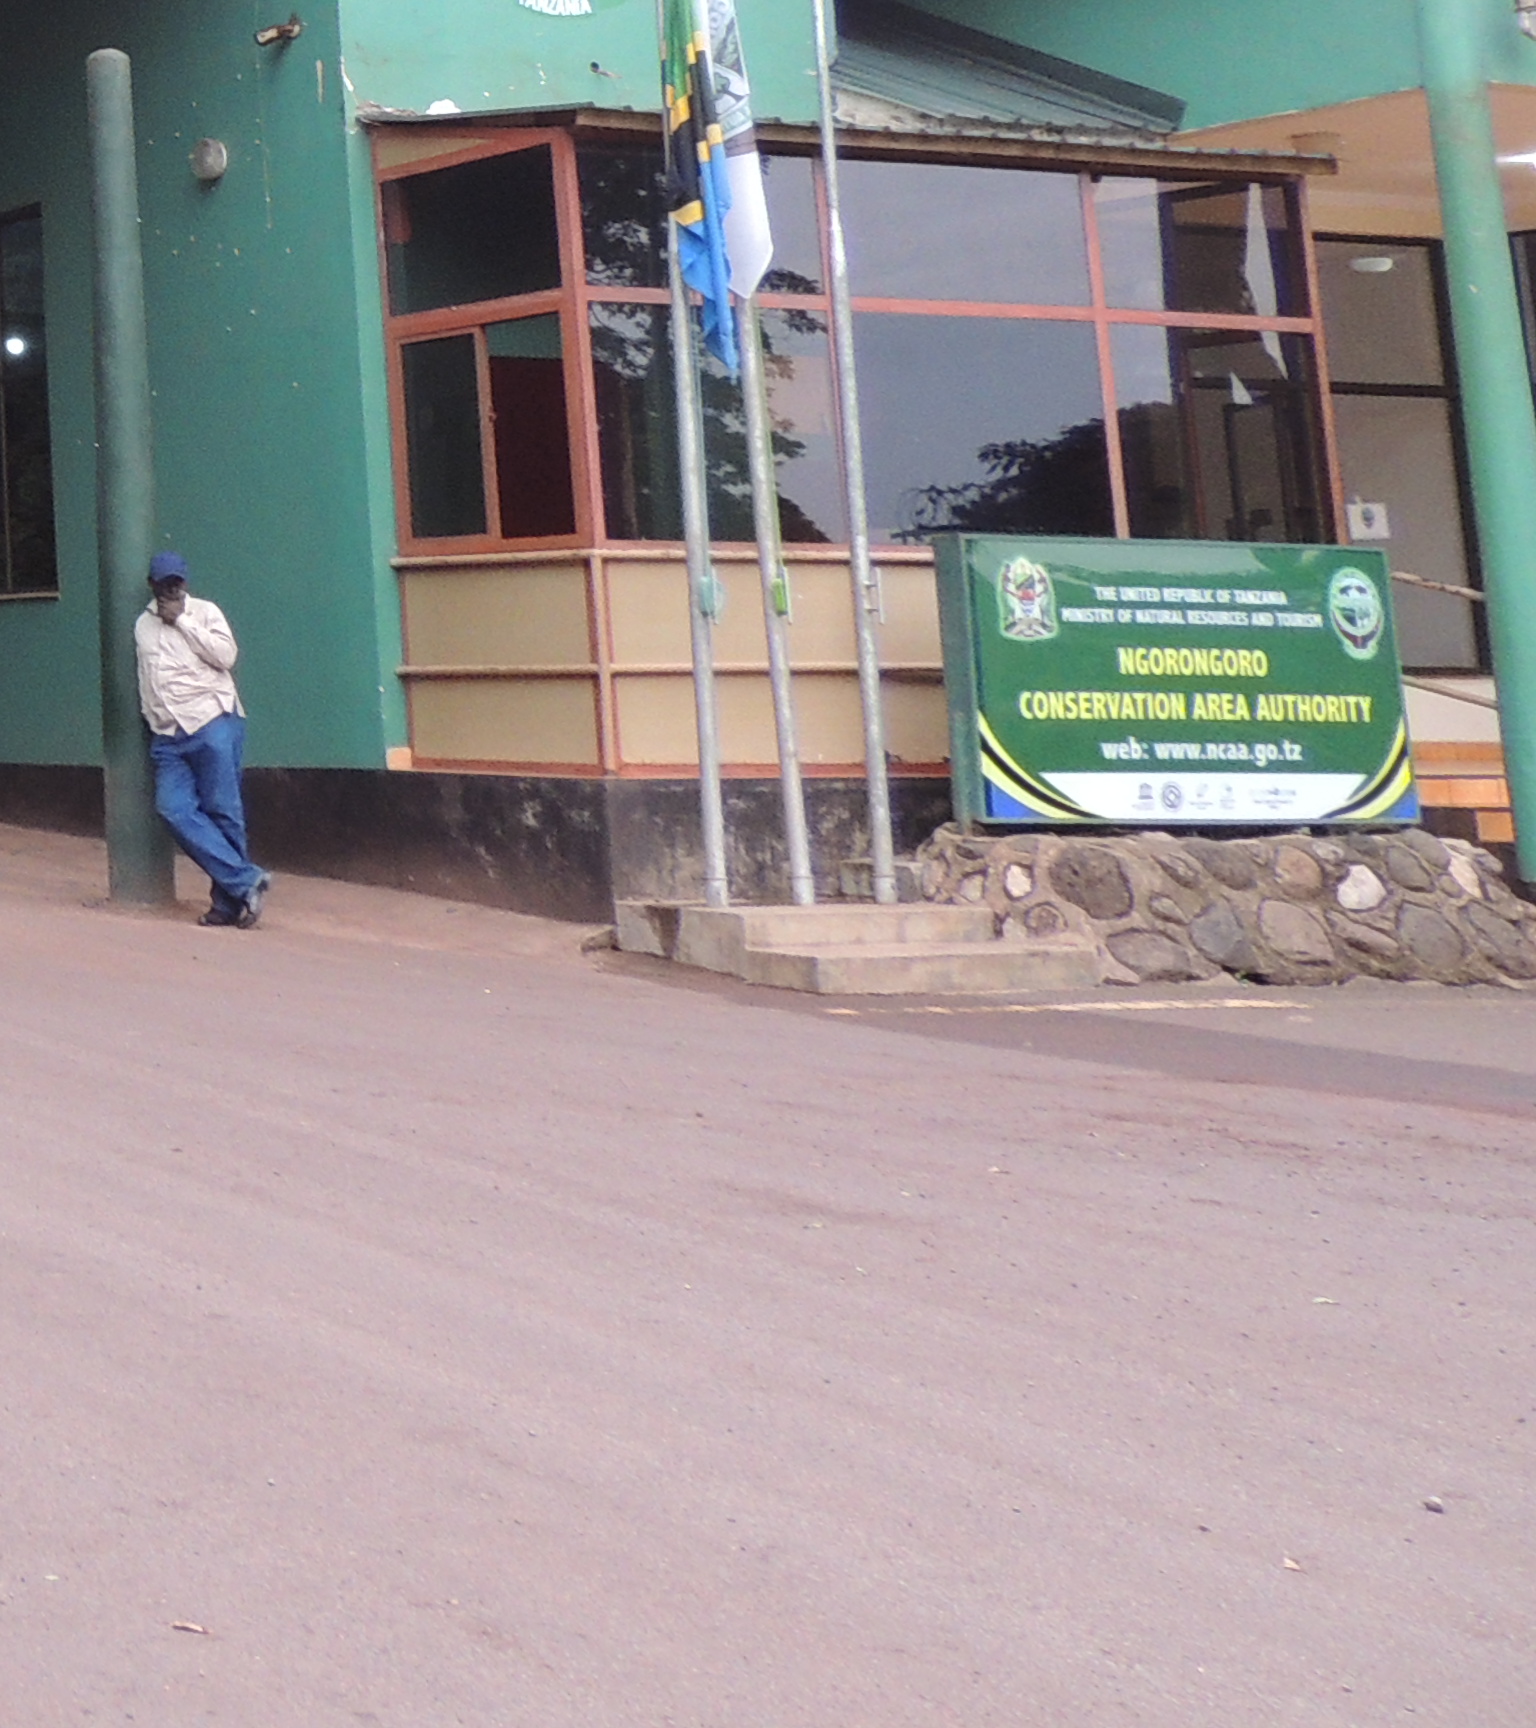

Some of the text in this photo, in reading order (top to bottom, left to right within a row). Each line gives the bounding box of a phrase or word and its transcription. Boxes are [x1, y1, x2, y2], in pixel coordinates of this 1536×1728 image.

[1094, 586, 1288, 605] THE UNITED REPUBLIC OF TANZANIA
[1061, 608, 1324, 628] MINISTRY OF NATURAL RESOURCES AND TOURISM
[1117, 647, 1269, 677] NGORONGORO
[1019, 691, 1372, 723] CONSERVATION AREA AUTHORITY
[1100, 736, 1303, 767] web: www.ncaa.go.tz
